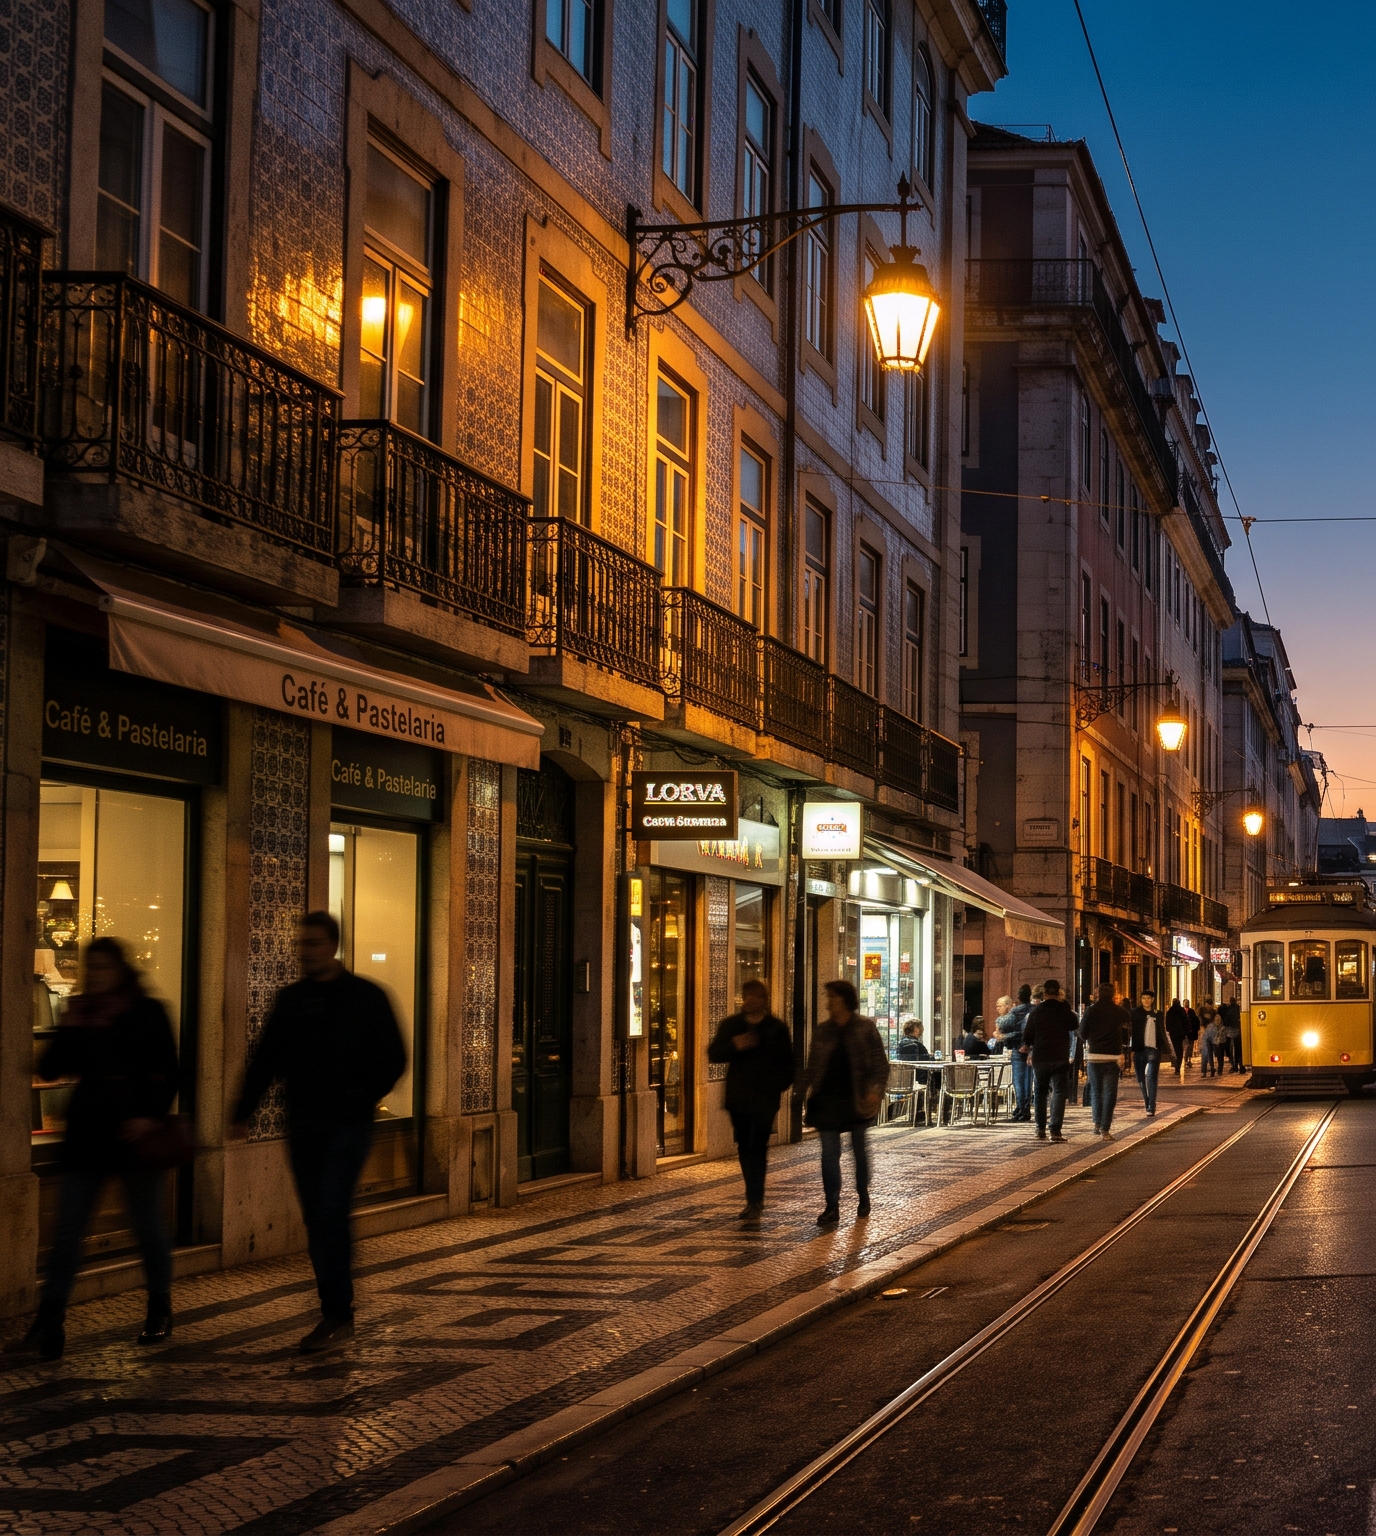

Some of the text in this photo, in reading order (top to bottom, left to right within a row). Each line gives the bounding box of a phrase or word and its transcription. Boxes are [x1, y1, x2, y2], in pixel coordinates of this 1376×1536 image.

[46, 700, 207, 756] Café & Pastelaria
[282, 674, 445, 744] Café & Pastelaria
[332, 759, 436, 799] Café & Pastelaria
[646, 783, 726, 802] LORVA
